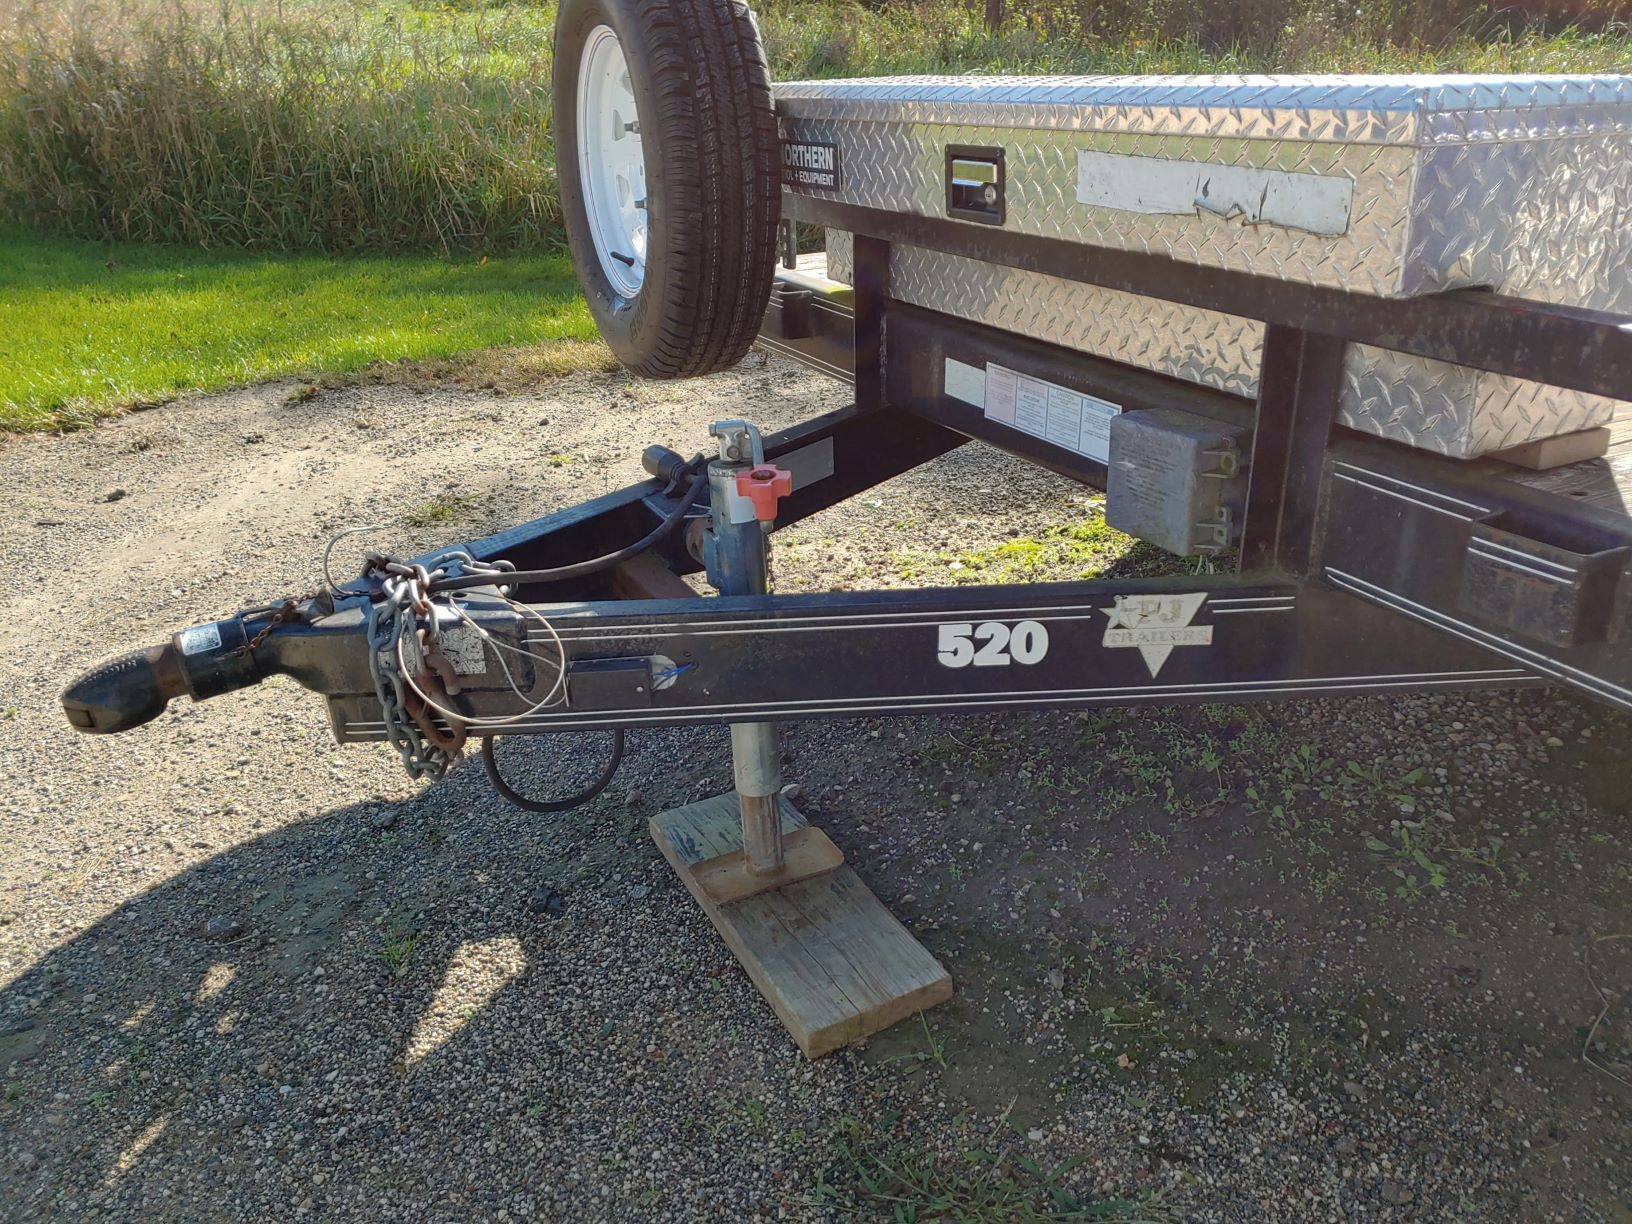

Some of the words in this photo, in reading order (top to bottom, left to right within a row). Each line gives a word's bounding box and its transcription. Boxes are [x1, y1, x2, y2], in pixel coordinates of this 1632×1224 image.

[782, 143, 834, 170] ORTHERN
[800, 170, 834, 186] EQUIPMENT
[938, 621, 1049, 668] 520
